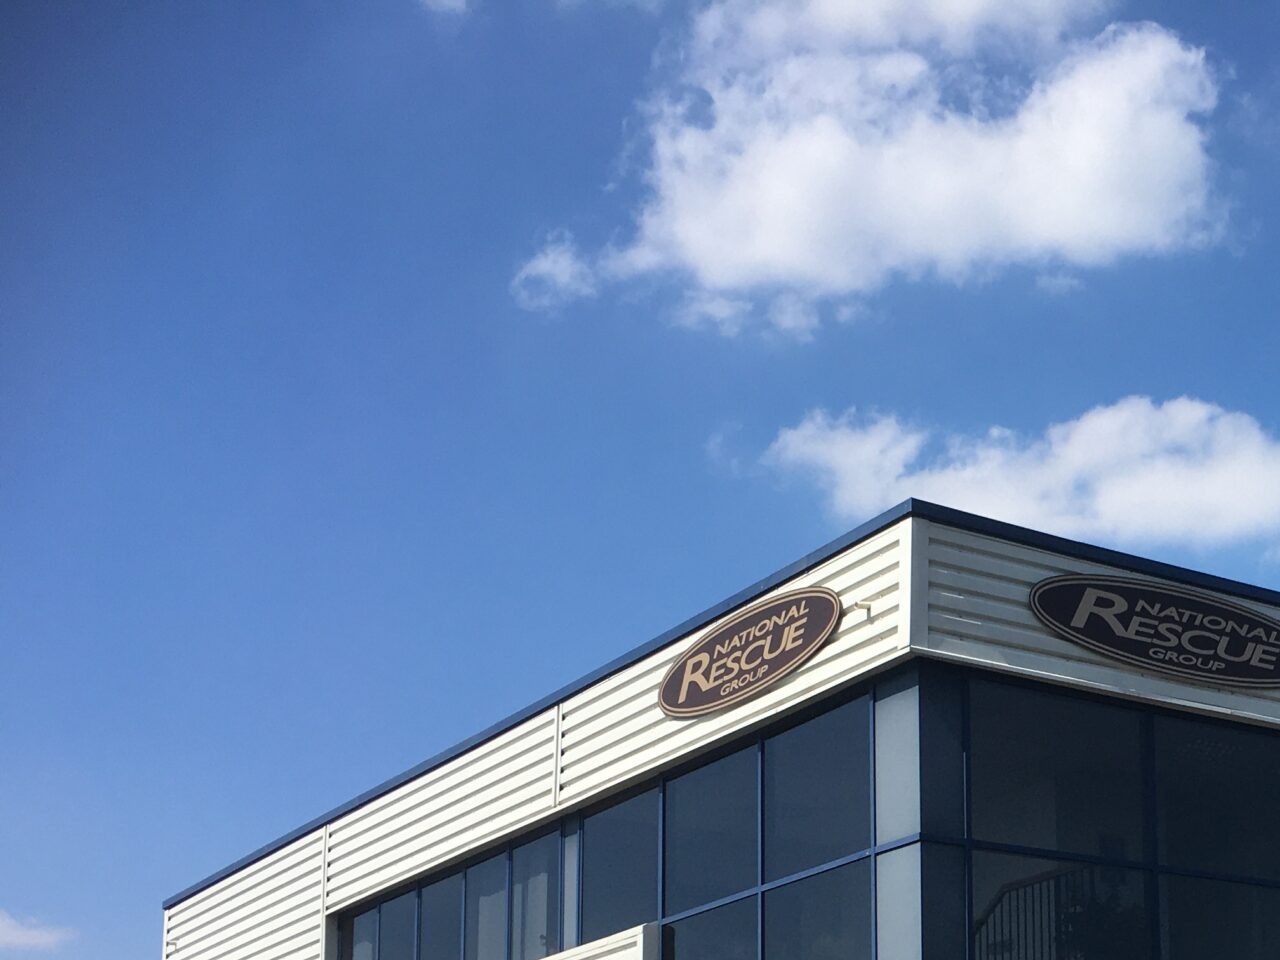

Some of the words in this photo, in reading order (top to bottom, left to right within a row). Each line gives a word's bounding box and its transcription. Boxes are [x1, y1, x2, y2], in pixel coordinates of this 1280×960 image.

[713, 600, 810, 659] NATIONAL
[1070, 587, 1280, 670] RESCUE
[678, 617, 807, 704] RESCUE
[720, 664, 769, 696] GROUP
[1149, 648, 1226, 671] GROUP
